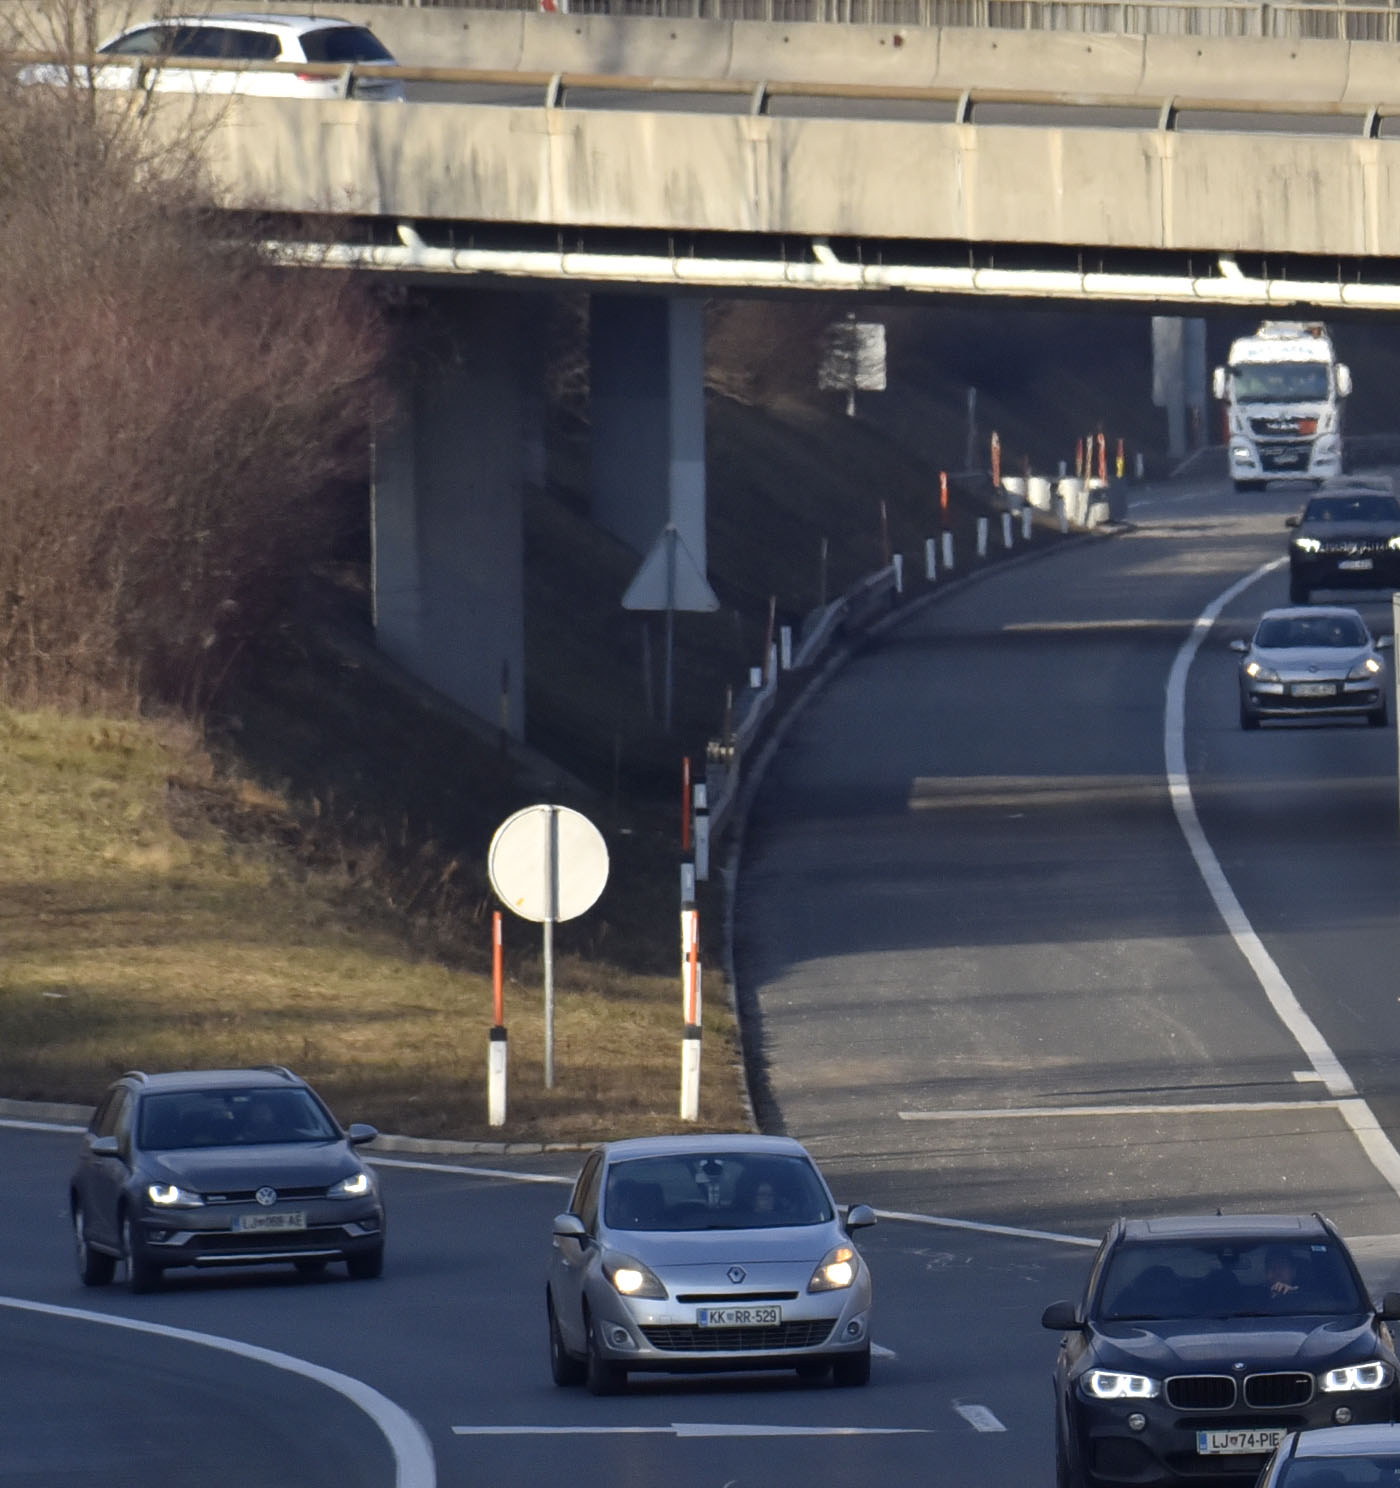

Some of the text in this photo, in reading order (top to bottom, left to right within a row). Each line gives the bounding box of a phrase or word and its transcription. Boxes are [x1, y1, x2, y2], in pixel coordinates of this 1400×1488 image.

[710, 1310, 777, 1324] KK RR-529
[1213, 1432, 1281, 1449] LJ 74-PIE
